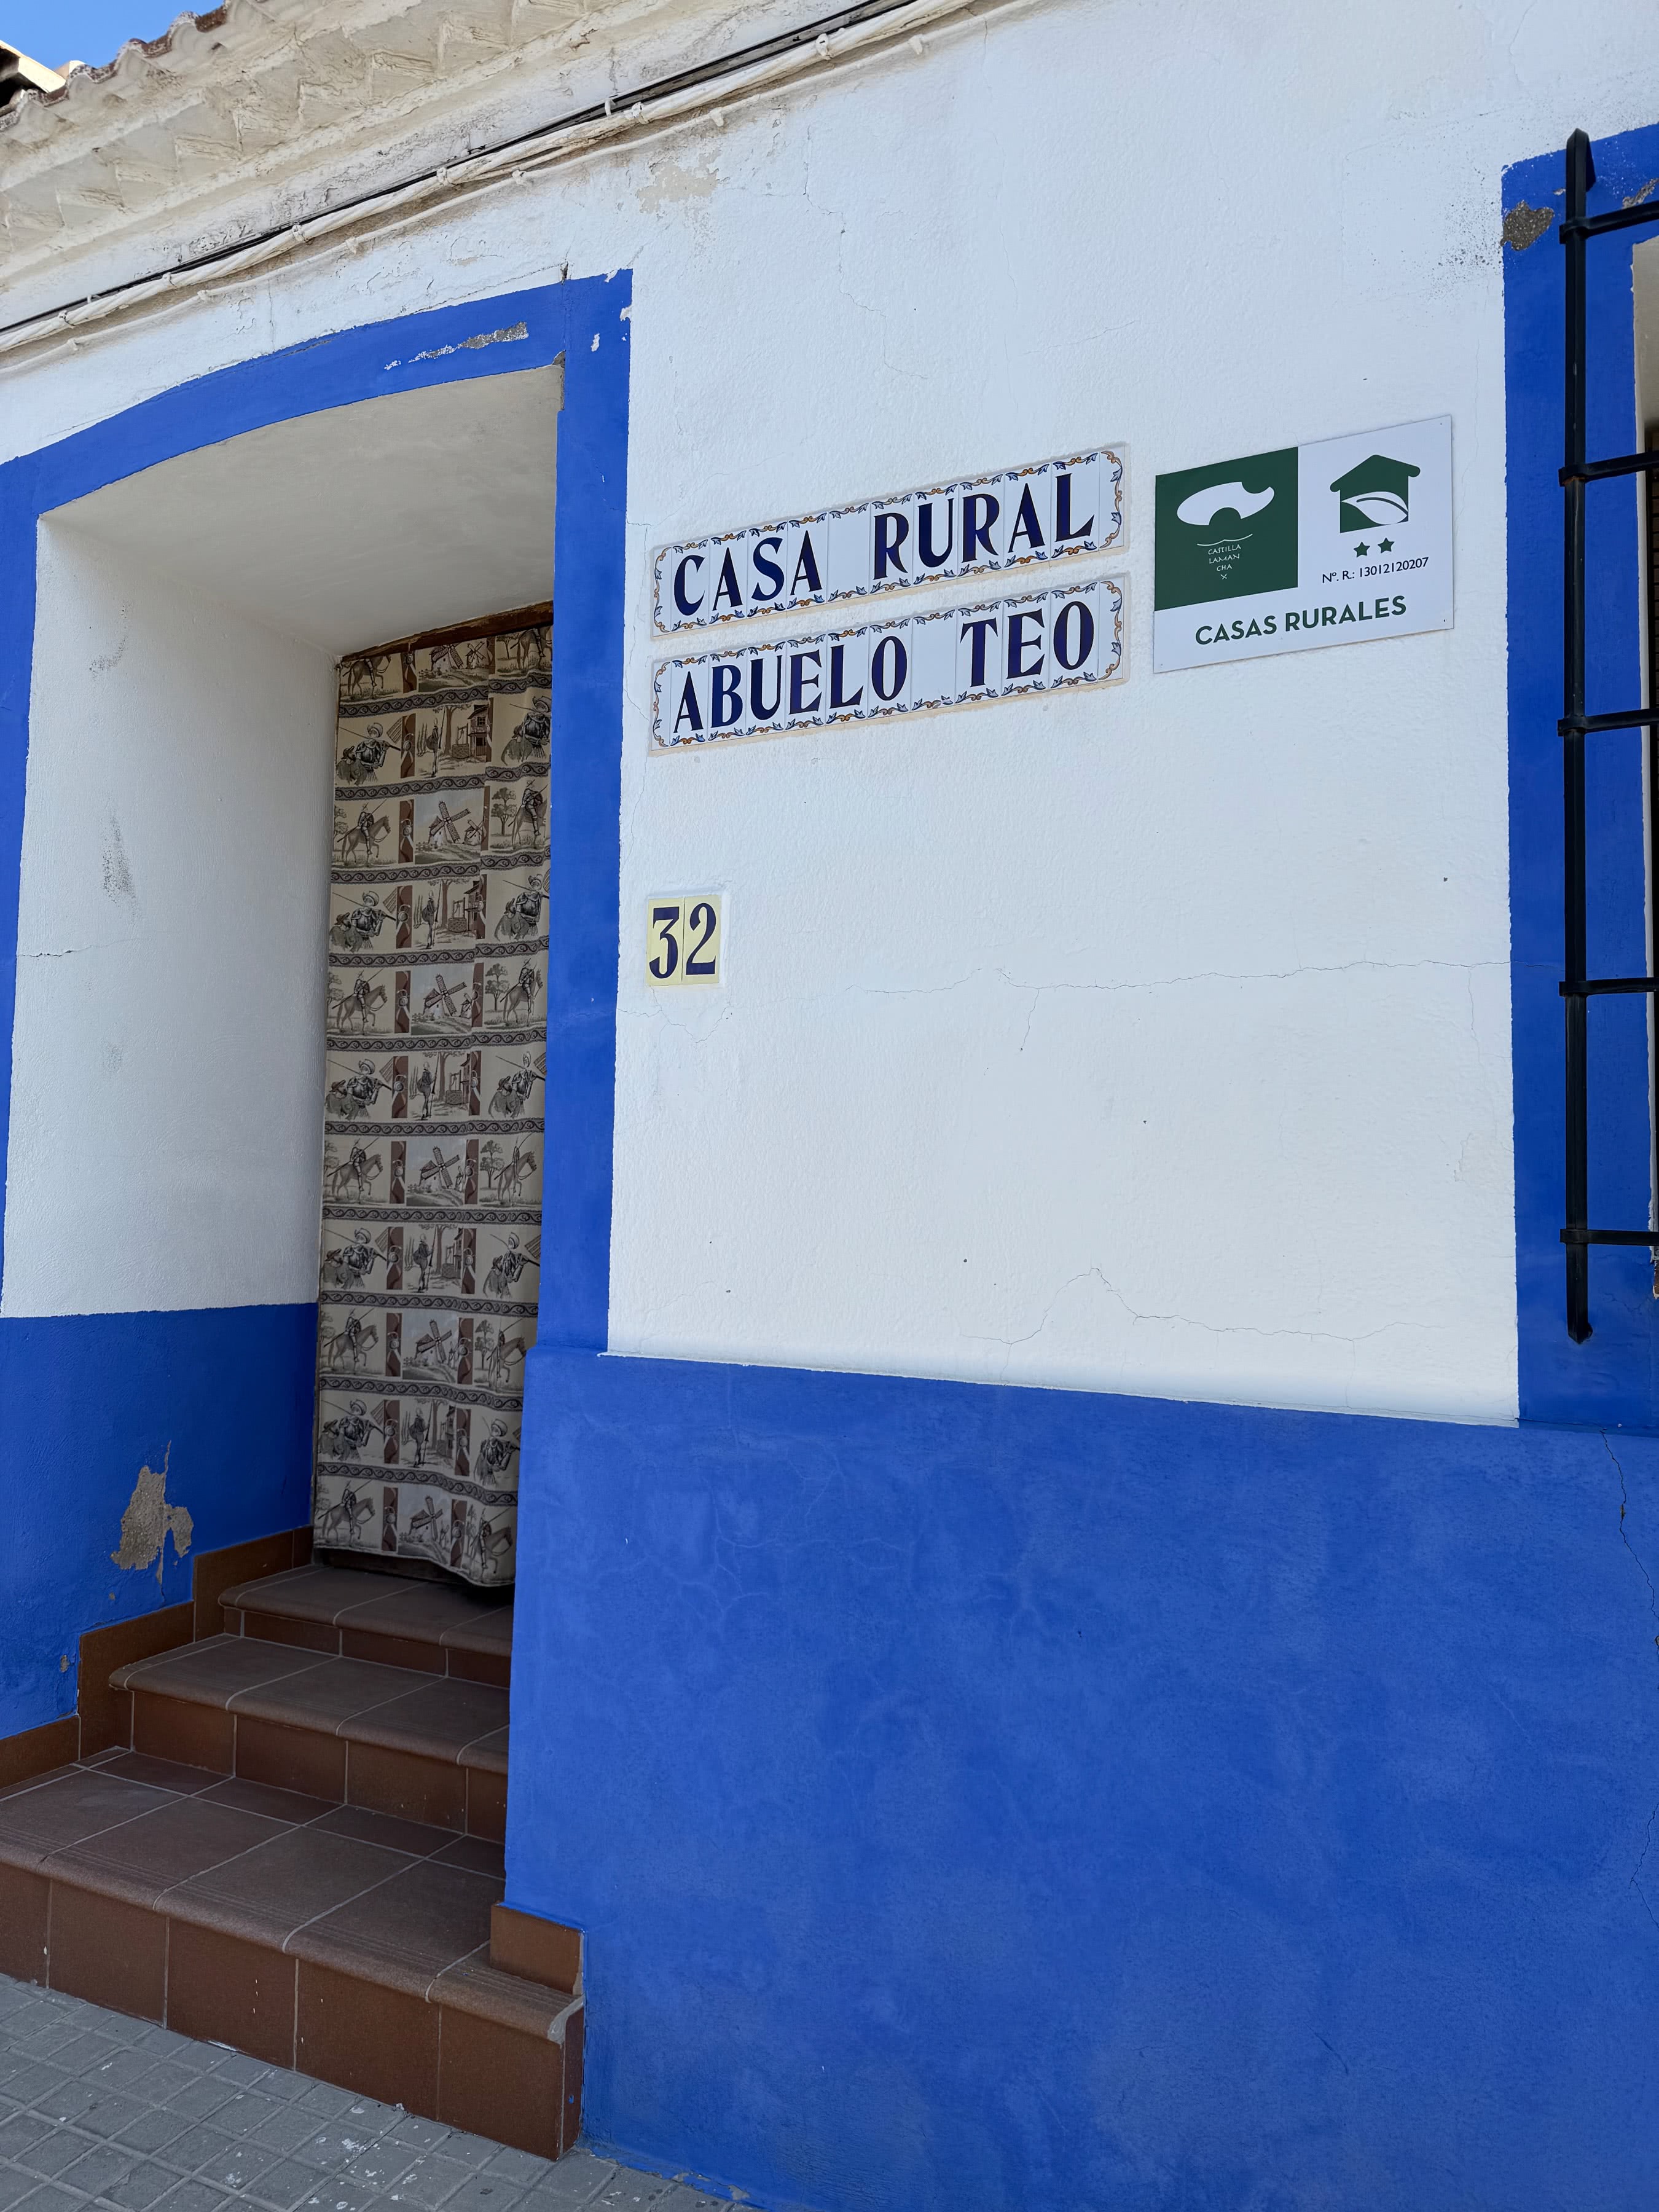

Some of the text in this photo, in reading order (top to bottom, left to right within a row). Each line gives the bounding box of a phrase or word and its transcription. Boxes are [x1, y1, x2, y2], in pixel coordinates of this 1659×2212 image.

[673, 473, 1095, 616] CASA RURAL
[1208, 544, 1241, 555] CASTILLA
[1209, 554, 1240, 564] LAMAN
[1360, 557, 1429, 578] 13012120207
[1195, 595, 1407, 645] CASAS RURALES
[673, 600, 1094, 733] ABUELO TEO
[649, 903, 716, 978] 32
